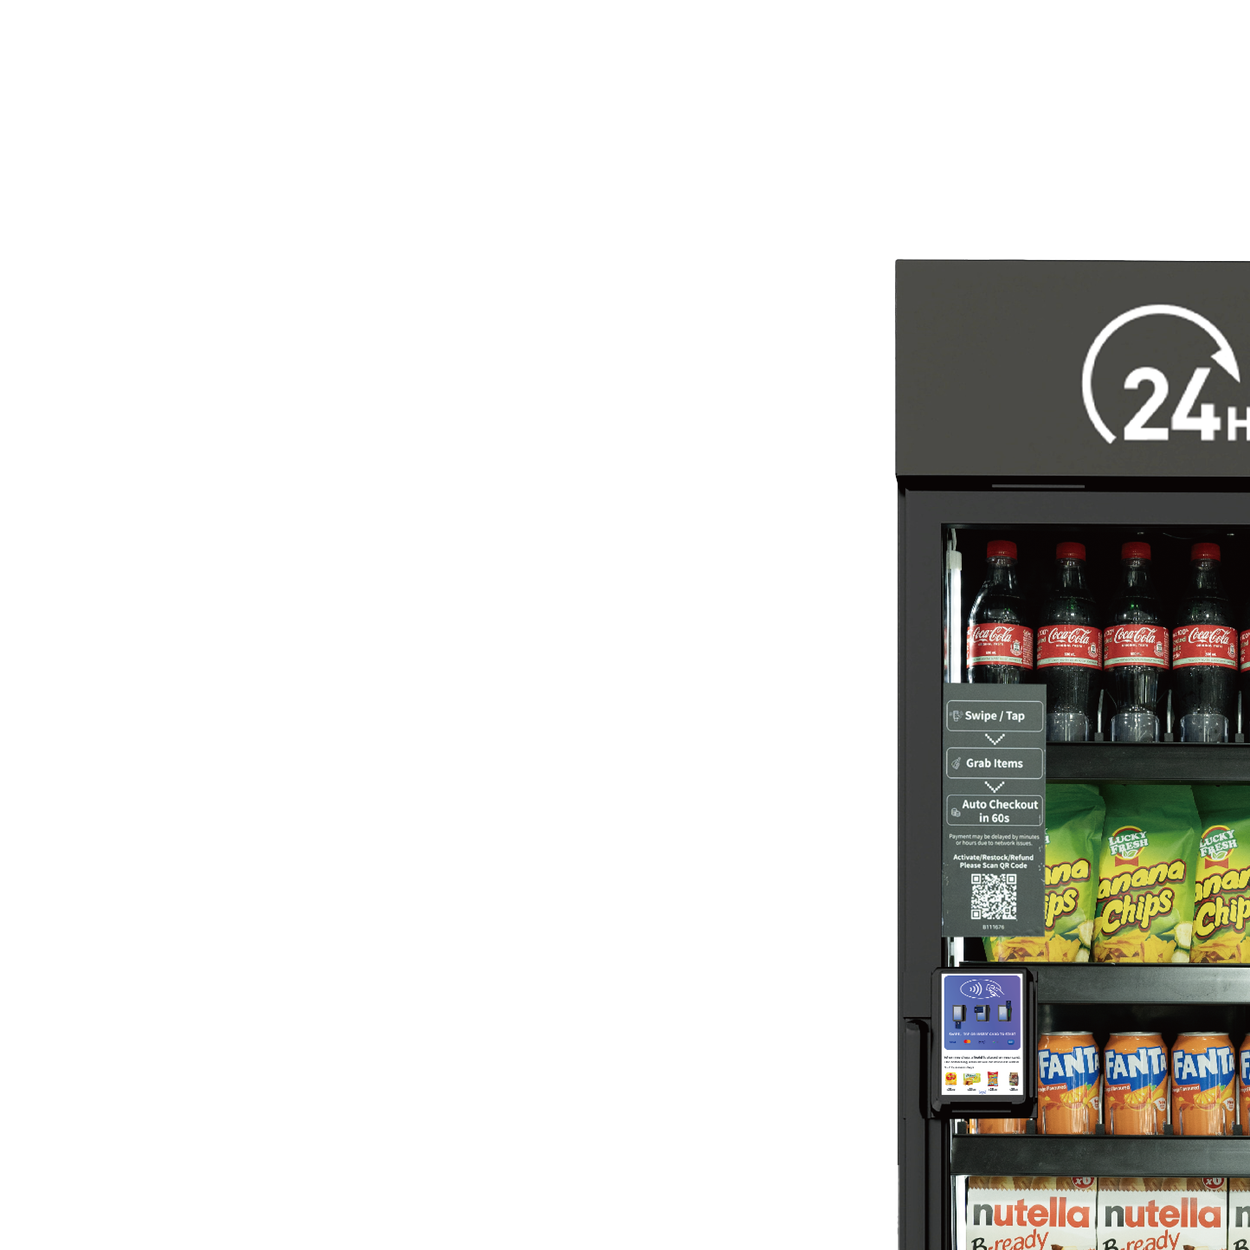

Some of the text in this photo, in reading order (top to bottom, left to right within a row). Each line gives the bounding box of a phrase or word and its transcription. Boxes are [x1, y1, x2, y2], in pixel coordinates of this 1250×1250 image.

[973, 626, 1015, 643] Coca-Cola
[1048, 627, 1092, 644] Coca-Cola
[1114, 627, 1157, 643] Coca-Cola
[1188, 627, 1231, 645] Coca-Cola
[965, 710, 997, 722] Swipe
[1006, 711, 1026, 723] Tap
[966, 758, 1024, 768] Grab Items
[962, 799, 1039, 810] Auto Checkout
[979, 812, 1010, 823] in 60s
[1108, 831, 1147, 846] LUCKY
[1200, 830, 1235, 848] LUCKY
[1110, 839, 1149, 856] FRESH
[1200, 839, 1238, 858] FRESH
[999, 862, 1010, 870] QR
[1102, 888, 1174, 934] Chips
[973, 1196, 1090, 1228] nutella
[1105, 1197, 1221, 1228] nutella
